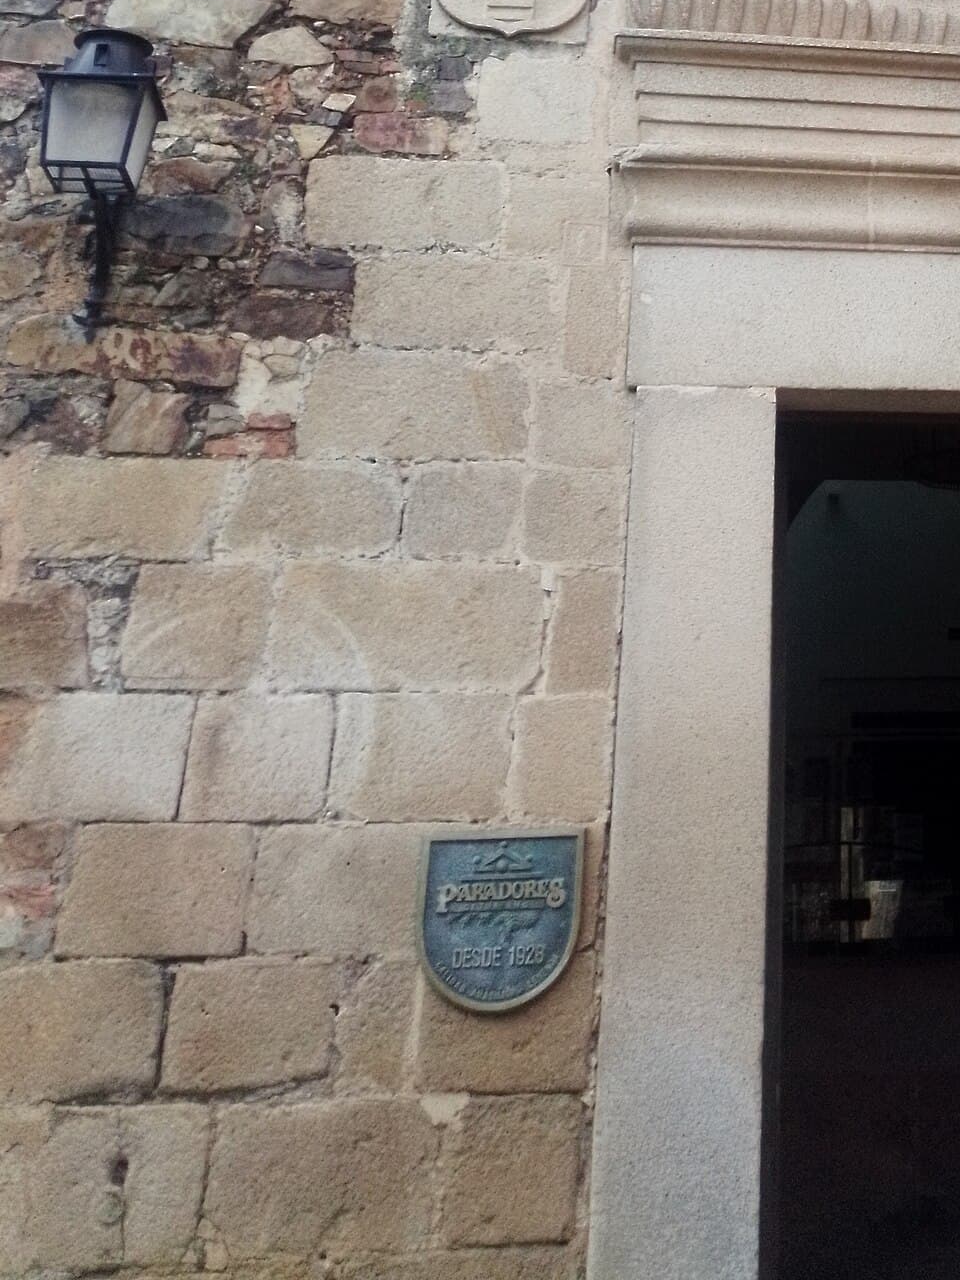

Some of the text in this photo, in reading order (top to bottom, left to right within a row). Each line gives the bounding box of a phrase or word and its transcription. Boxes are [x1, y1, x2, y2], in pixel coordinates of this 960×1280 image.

[435, 877, 566, 913] PARADORES
[452, 943, 546, 969] DESDE 1928
